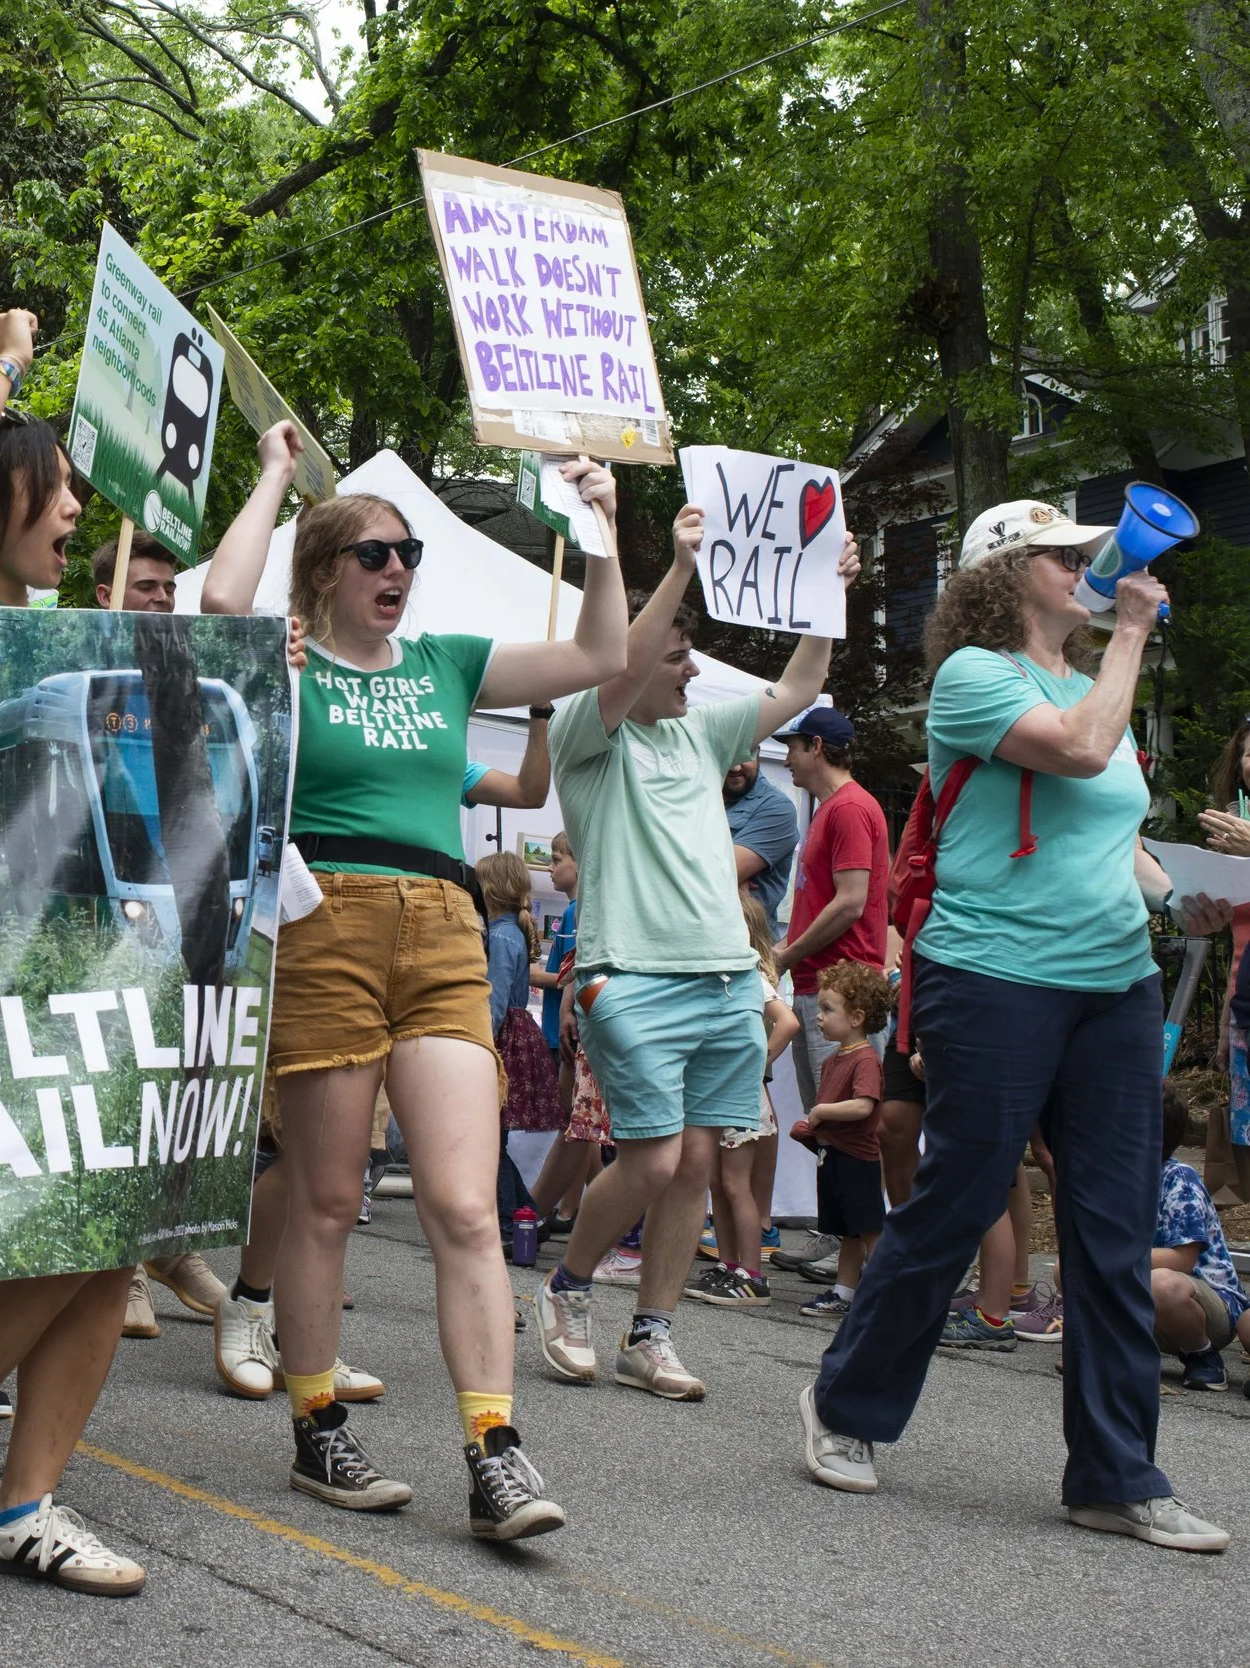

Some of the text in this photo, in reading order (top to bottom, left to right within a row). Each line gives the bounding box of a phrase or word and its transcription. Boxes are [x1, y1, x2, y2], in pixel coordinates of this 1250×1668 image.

[443, 192, 609, 248] AMSTERDAM
[105, 252, 162, 326] Greenway rail
[450, 245, 622, 298] WALK DOESN'T
[96, 306, 140, 362] 45 Atlanta
[101, 278, 147, 338] to connect
[462, 291, 637, 347] WORK WITHOUT
[92, 333, 156, 407] neighborhoods
[474, 340, 656, 414] BELTLINE RAIL
[162, 506, 193, 541] BELTLINE
[715, 461, 795, 540] WE
[710, 539, 811, 629] RAIL
[315, 671, 435, 698] HOT GIRLS
[344, 691, 419, 715] WANT
[329, 704, 448, 730] BELTLINE
[363, 727, 428, 750] RAIL
[185, 1222, 200, 1236] photo
